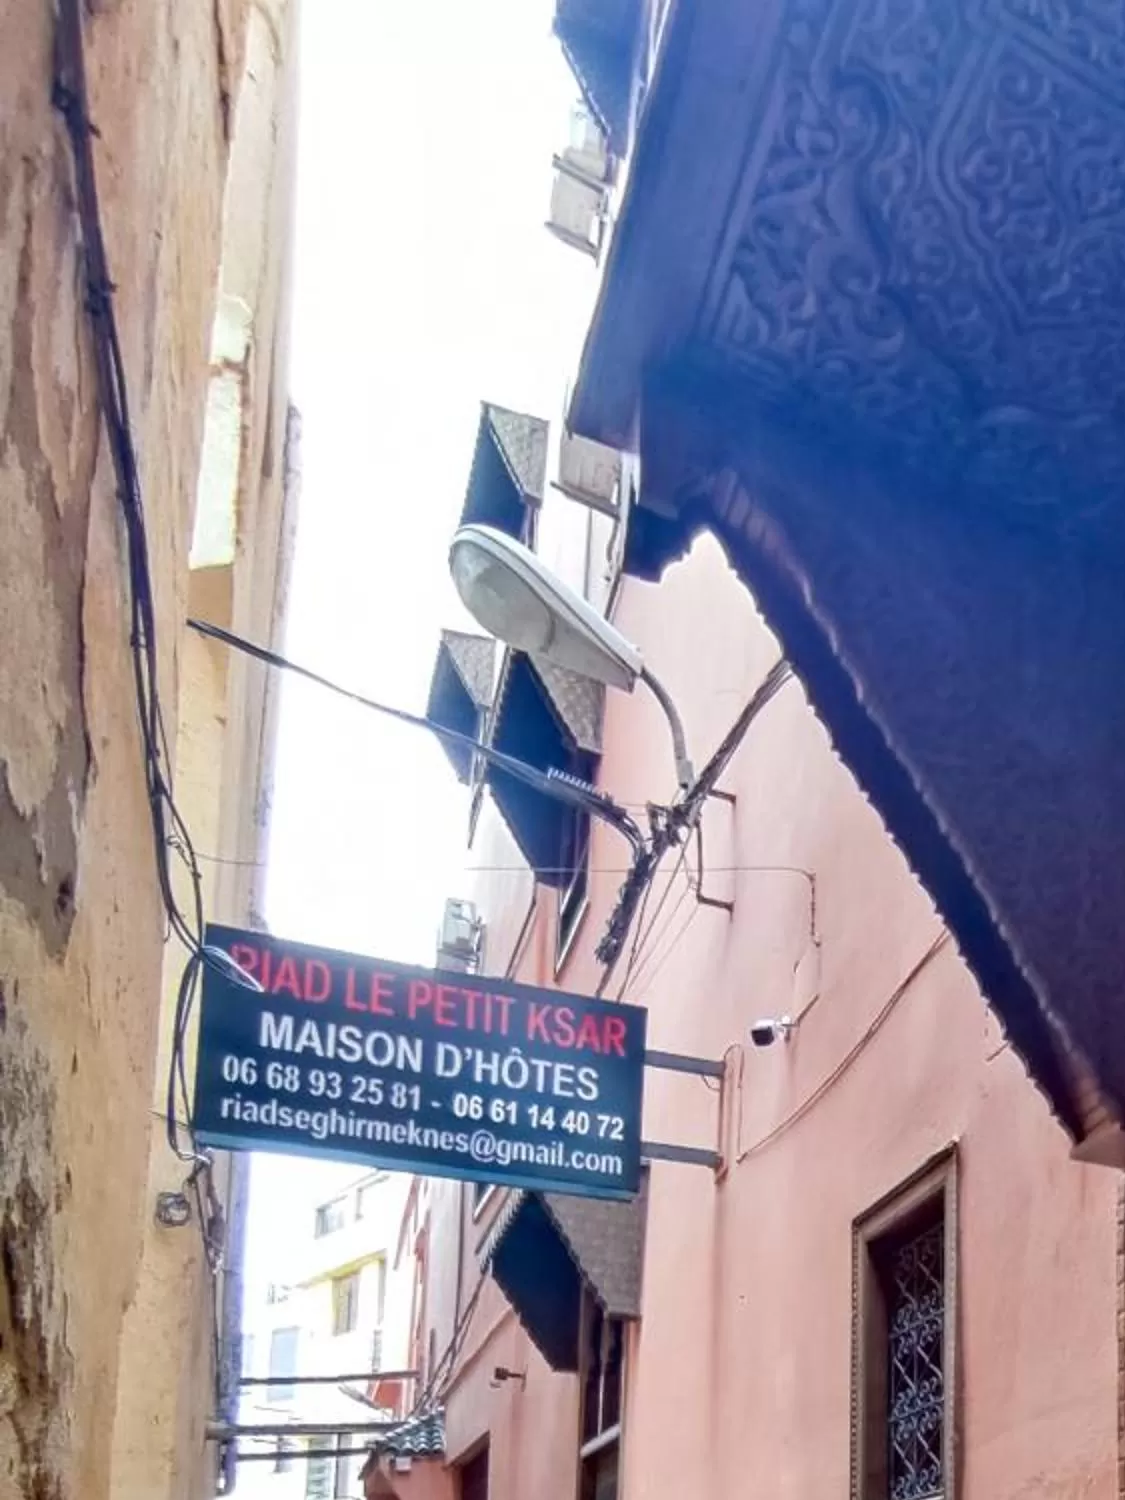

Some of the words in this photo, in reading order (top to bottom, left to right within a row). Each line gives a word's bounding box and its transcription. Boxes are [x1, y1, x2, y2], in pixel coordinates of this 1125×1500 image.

[259, 1011, 424, 1073] MAISON
[436, 1041, 599, 1100] D'HÔTES
[345, 967, 396, 1016] LE
[407, 979, 515, 1036] PETIT
[526, 1003, 627, 1057] KSAR
[220, 1092, 623, 1176] riadseghirmeknes@gmail.com
[222, 1055, 258, 1085] 06
[266, 1062, 300, 1093] 68
[308, 1069, 342, 1099] 93
[351, 1076, 384, 1105] 25
[390, 1083, 421, 1111] 81
[431, 1100, 442, 1109] -
[453, 1093, 484, 1120] 06
[489, 1099, 519, 1125] 61
[527, 1104, 556, 1131] 14
[561, 1110, 590, 1136] 40
[597, 1114, 625, 1141] 72
